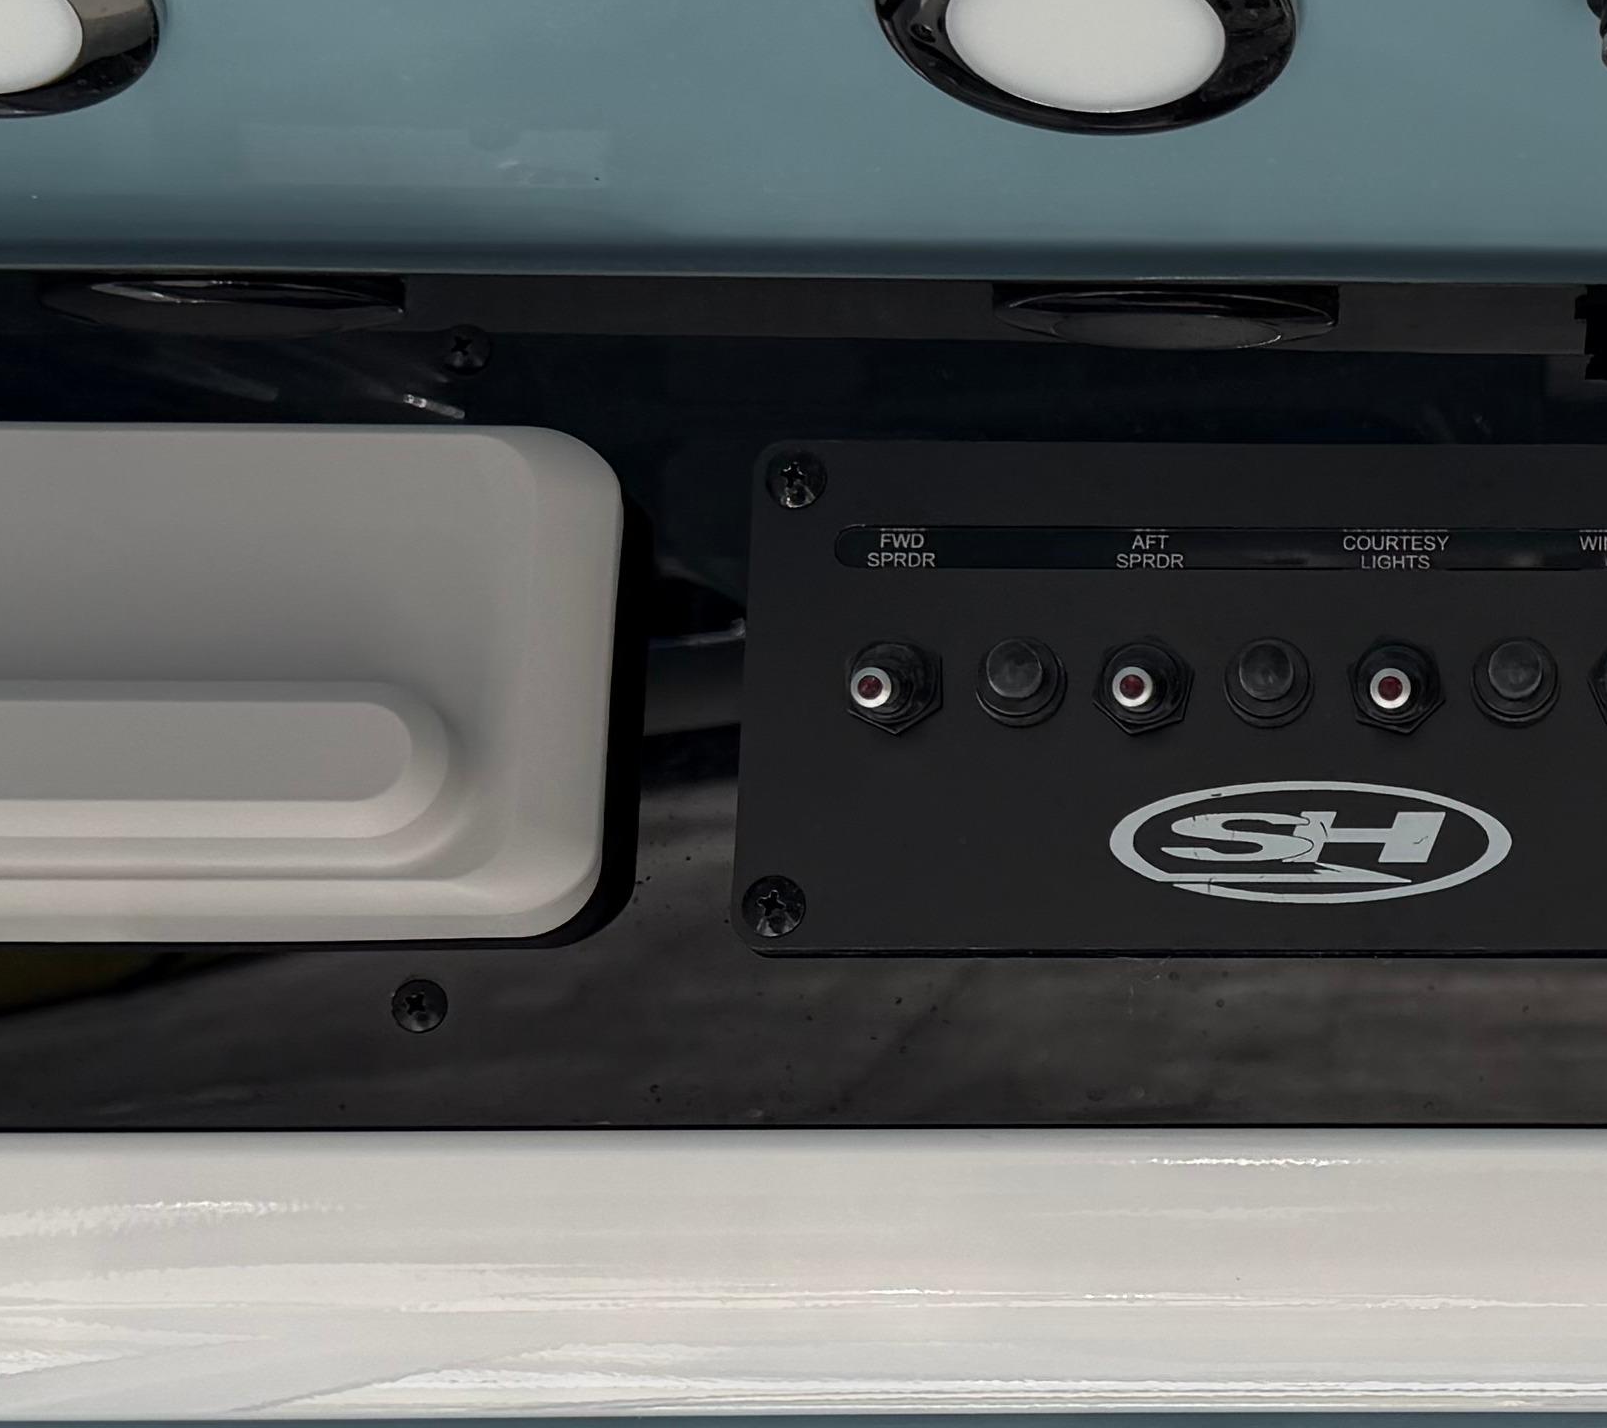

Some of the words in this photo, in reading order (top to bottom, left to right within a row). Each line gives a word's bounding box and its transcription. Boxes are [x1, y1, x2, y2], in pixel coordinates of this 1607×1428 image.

[879, 532, 926, 550] FWD
[1131, 534, 1170, 551] AFT
[1342, 535, 1451, 552] COURTESY
[866, 551, 937, 569] SPRDR
[1115, 552, 1185, 570] SPRDR
[1360, 554, 1431, 571] LIGHTS
[1159, 810, 1447, 864] SH
